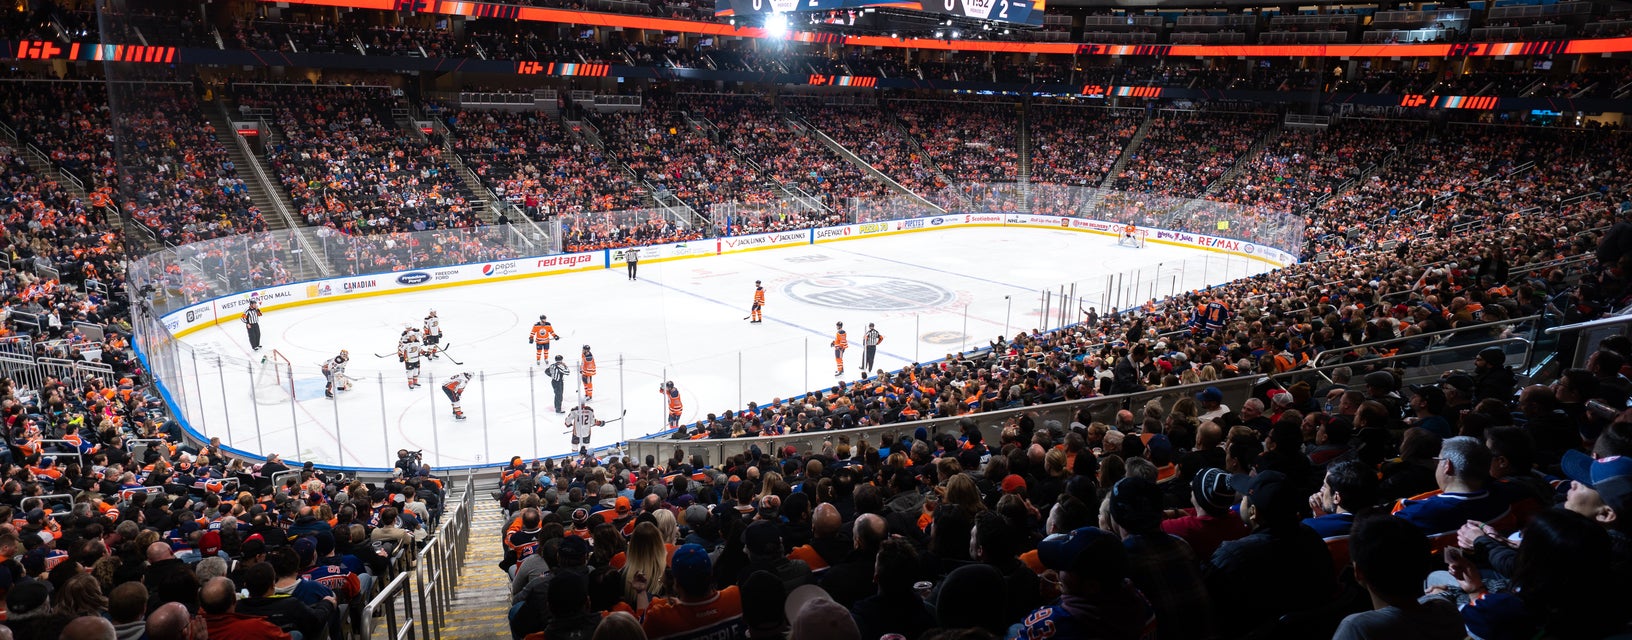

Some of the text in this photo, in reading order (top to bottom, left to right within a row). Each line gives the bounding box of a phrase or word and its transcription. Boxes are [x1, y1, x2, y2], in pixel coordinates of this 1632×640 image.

[999, 0, 1009, 18] 2
[817, 228, 844, 239] SAFEWAY
[859, 222, 879, 234] PIZZA
[738, 239, 750, 247] JACK
[779, 234, 791, 242] JACK
[1198, 236, 1240, 251] RE/MAX
[495, 261, 516, 271] pepsi
[343, 280, 377, 290] CANADIAN
[221, 291, 292, 310] WEST EDMONTON MALL
